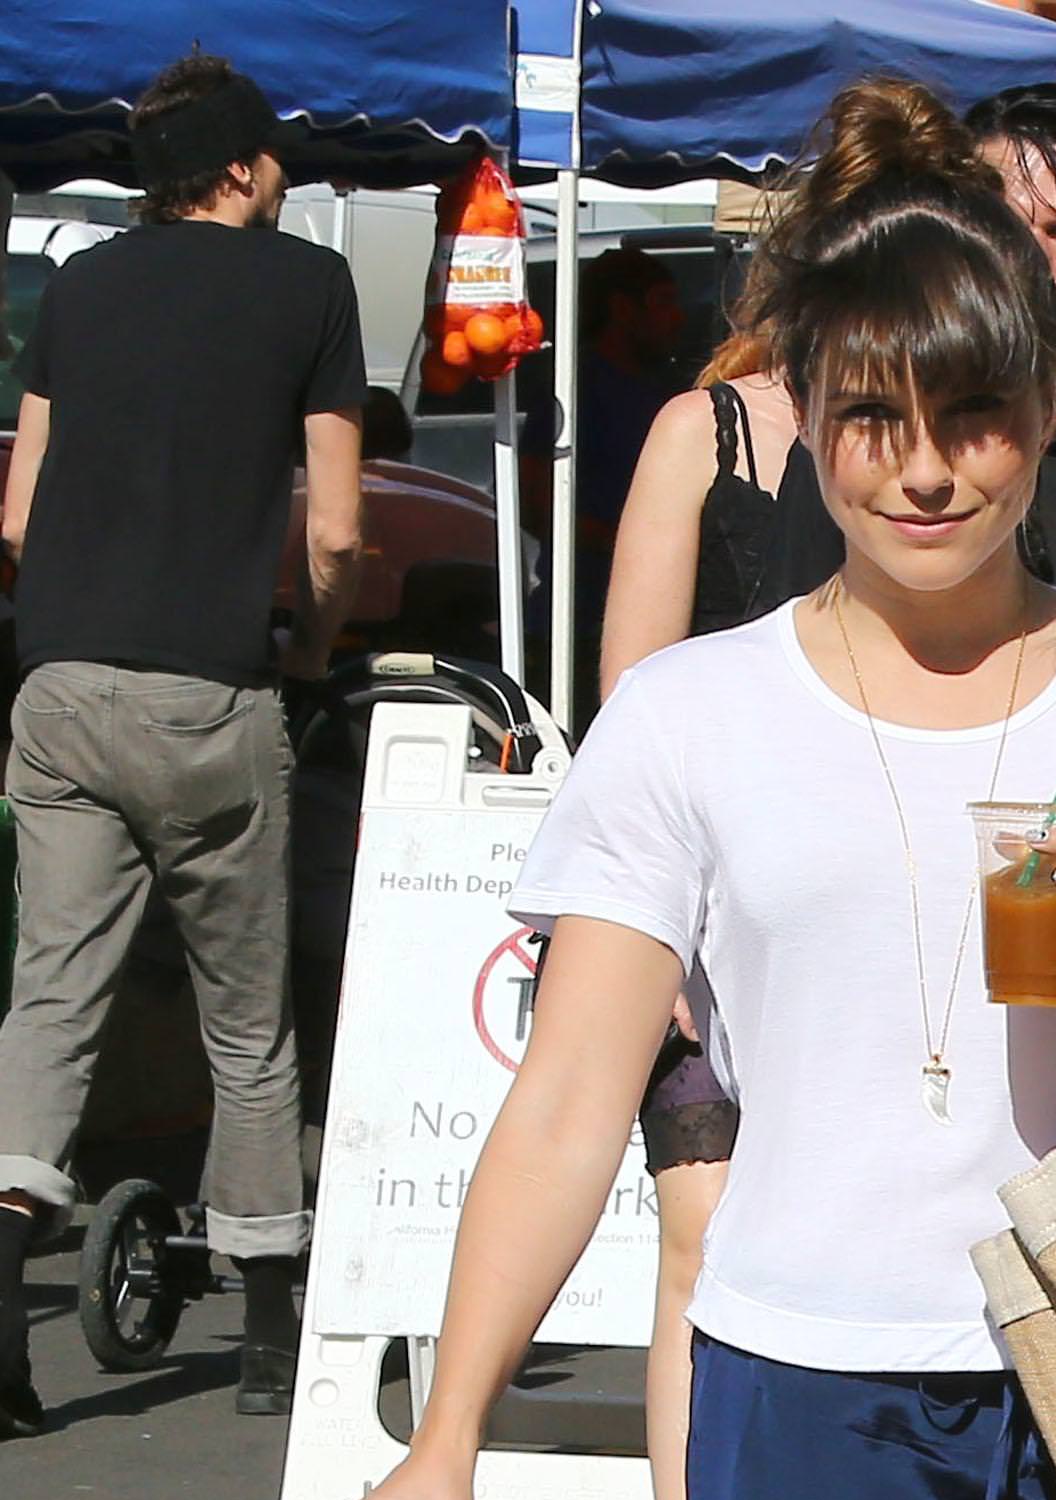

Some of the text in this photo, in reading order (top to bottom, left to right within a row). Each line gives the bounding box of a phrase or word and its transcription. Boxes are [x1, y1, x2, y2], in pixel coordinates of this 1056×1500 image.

[491, 842, 528, 862] Ple
[379, 872, 513, 899] Health Dep
[410, 1101, 478, 1140] No
[376, 1168, 416, 1207] in
[434, 1169, 471, 1208] th
[554, 1288, 602, 1310] you!
